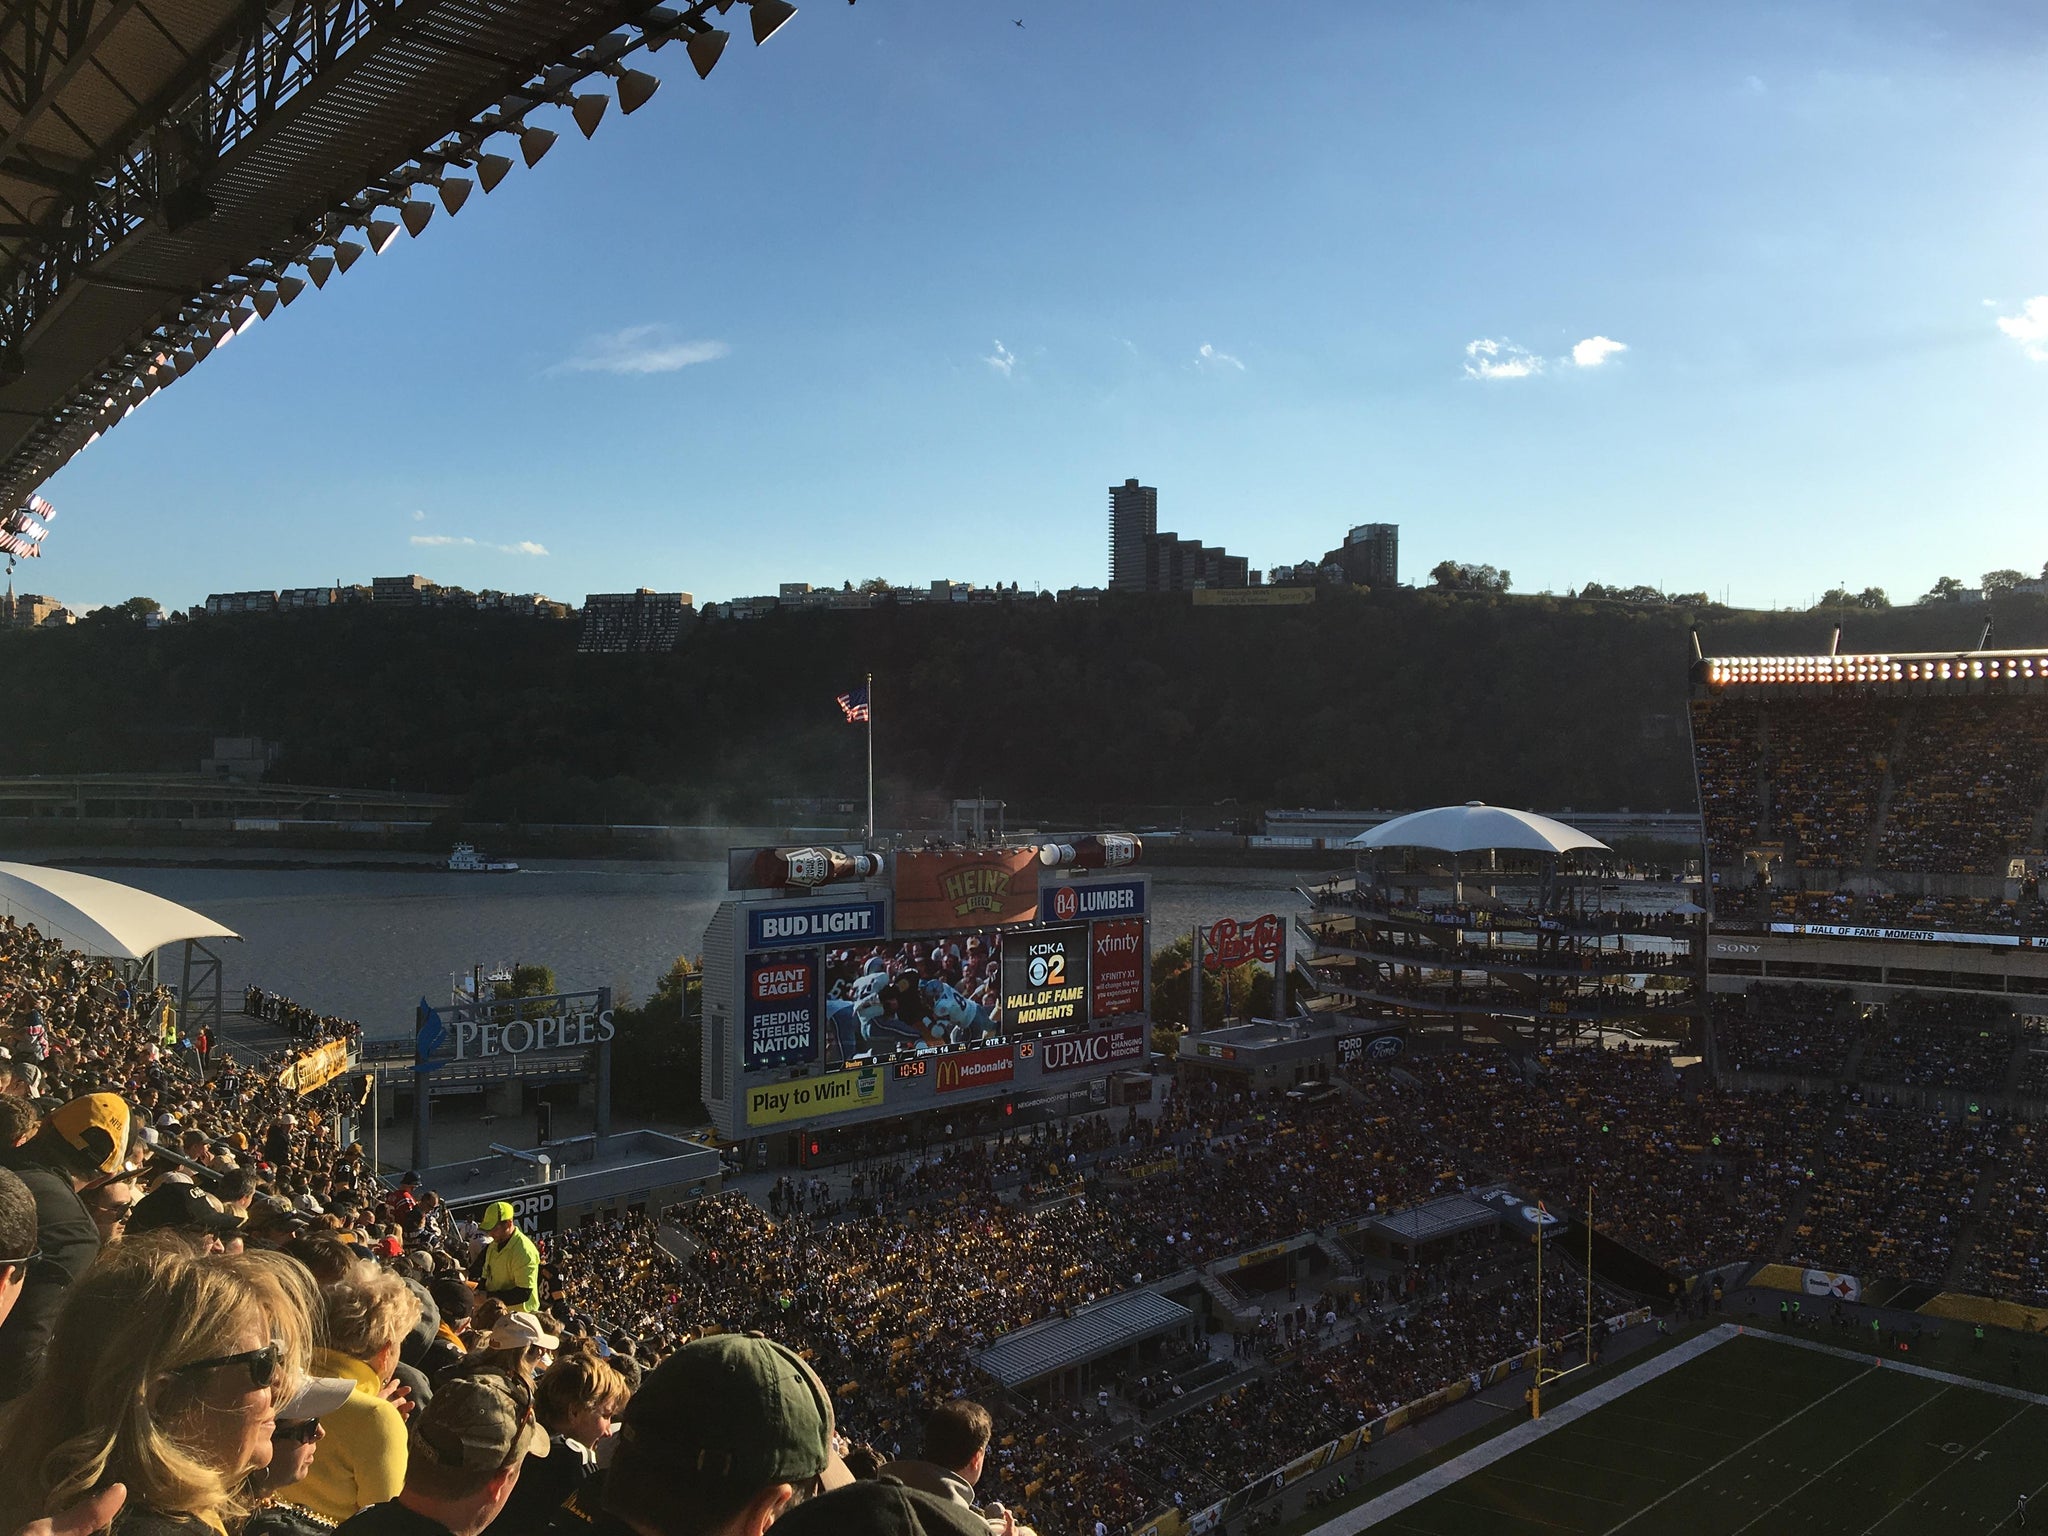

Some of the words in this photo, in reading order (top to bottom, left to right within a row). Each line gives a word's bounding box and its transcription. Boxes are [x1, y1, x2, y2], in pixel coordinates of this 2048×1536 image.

[946, 869, 1011, 900] HEINZ
[970, 896, 990, 907] FIELD
[1057, 893, 1075, 914] 84
[1080, 889, 1134, 912] LUMBER
[763, 916, 808, 938] BUD
[811, 911, 871, 934] LIGHT
[1811, 925, 1835, 935] HALL
[1838, 927, 1850, 935] OF
[1854, 928, 1880, 938] FAME
[1884, 930, 1935, 940] MOMENTS
[1029, 942, 1065, 956] KDKA
[1097, 933, 1139, 957] xfinity
[1716, 943, 1761, 953] SONY
[757, 968, 805, 984] GIANT
[1047, 954, 1065, 985] 2
[1101, 970, 1127, 981] XFINITY
[758, 981, 804, 997] EAGLE
[1007, 993, 1035, 1009] HALL
[1037, 990, 1053, 1005] OF
[1054, 986, 1084, 1002] FAME
[753, 1009, 810, 1028] FEEDING
[1018, 1004, 1074, 1024] MOMENTS
[452, 1010, 616, 1062] PEOPLES
[752, 1022, 811, 1040] STEELERS
[1111, 1033, 1124, 1041] LIFE
[753, 1034, 810, 1055] NATION
[985, 1038, 999, 1046] QTR
[1111, 1038, 1143, 1049] CHANGING
[1338, 1037, 1362, 1051] FORD
[1372, 1039, 1397, 1059] Ford
[917, 1047, 938, 1057] PATRIOTS
[940, 1046, 949, 1054] 14
[1021, 1045, 1033, 1057] 25
[1043, 1035, 1108, 1069] UPMC
[1111, 1046, 1140, 1057] MEDICINE
[900, 1061, 925, 1077] 10:58
[960, 1058, 1013, 1077] McDonald's
[753, 1092, 789, 1114] Play
[793, 1089, 810, 1105] to
[814, 1079, 851, 1101] Win!
[109, 1116, 123, 1132] NFL
[511, 1194, 554, 1217] ORD
[1808, 1277, 1830, 1287] Steelers
